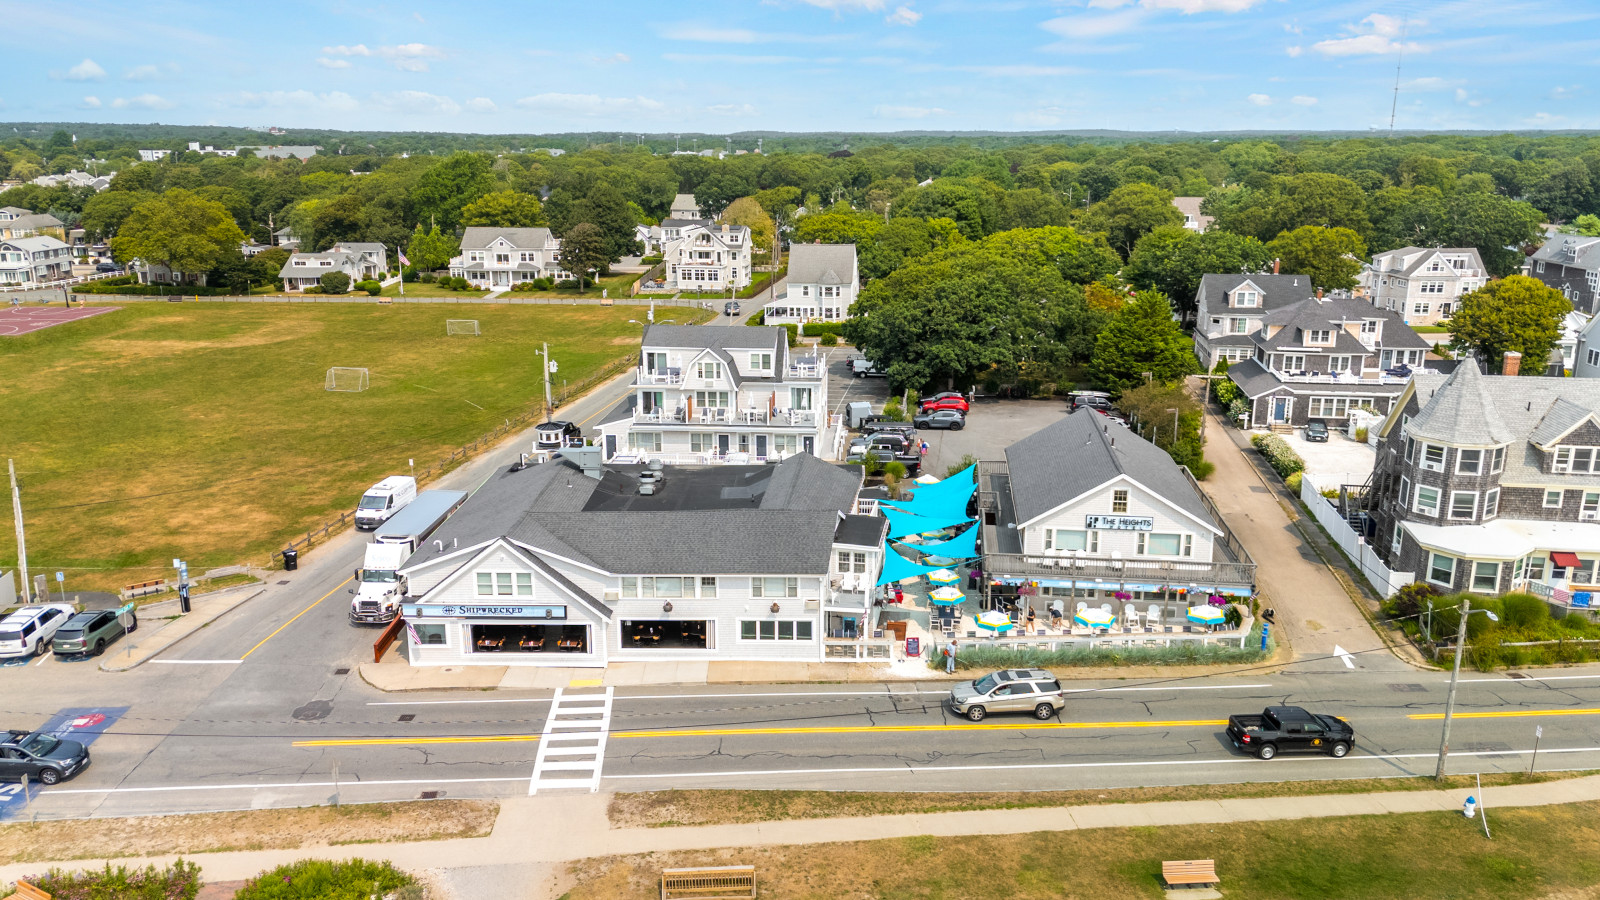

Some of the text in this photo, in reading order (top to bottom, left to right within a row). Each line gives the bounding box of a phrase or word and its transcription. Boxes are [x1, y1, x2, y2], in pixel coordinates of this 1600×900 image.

[1102, 517, 1152, 526] THE HEIGHTS
[459, 605, 523, 614] SHIPWRECKED
